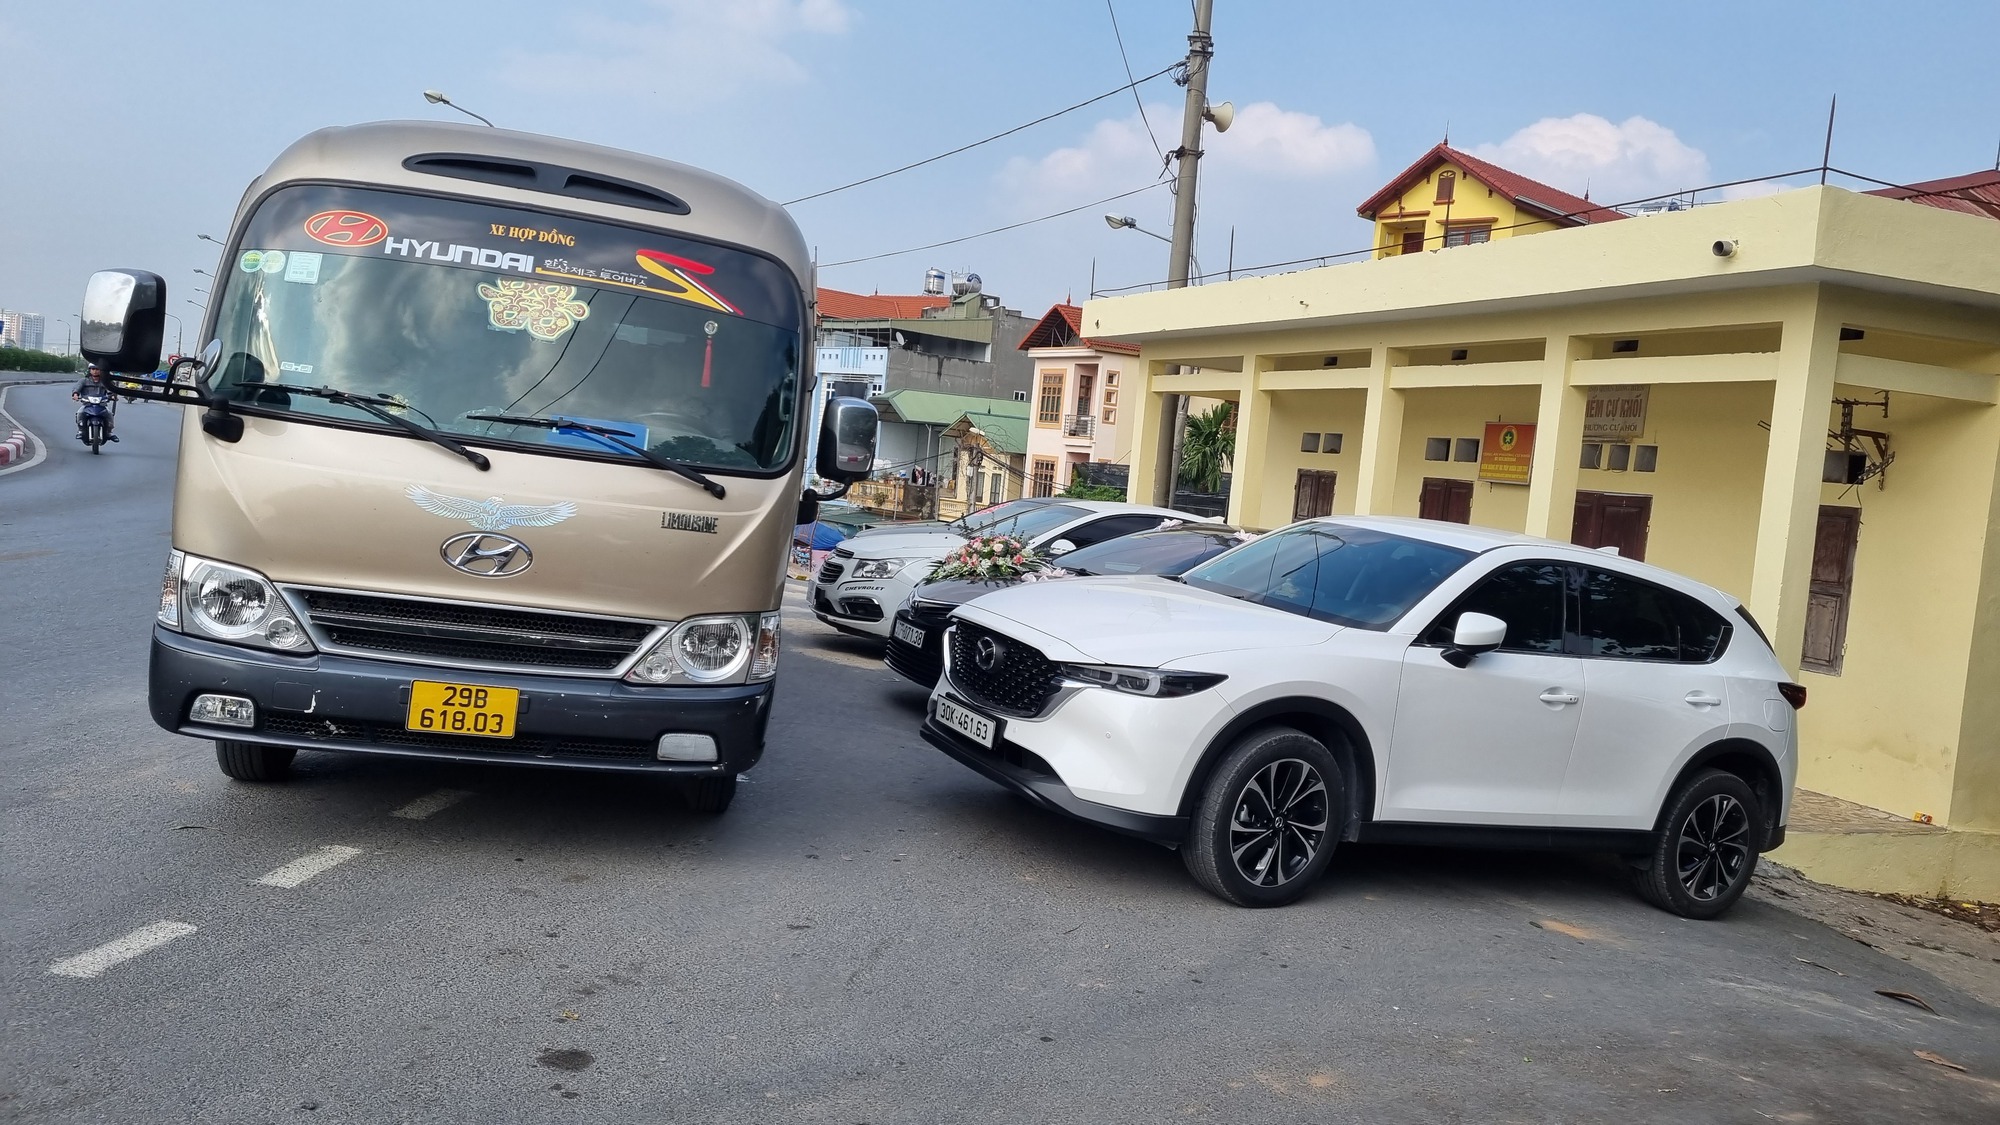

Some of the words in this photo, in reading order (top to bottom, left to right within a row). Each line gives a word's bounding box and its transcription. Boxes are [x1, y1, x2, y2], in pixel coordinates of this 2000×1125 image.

[489, 223, 506, 236] XE
[508, 226, 537, 242] HỢP
[538, 228, 576, 247] ĐỒNG
[384, 236, 535, 274] HYUNDAI
[1619, 393, 1643, 418] KHỐI
[661, 511, 719, 534] LIMOUSINE
[442, 686, 488, 709] 29B
[420, 708, 504, 734] 618.03
[940, 702, 988, 740] 30K-461.63
